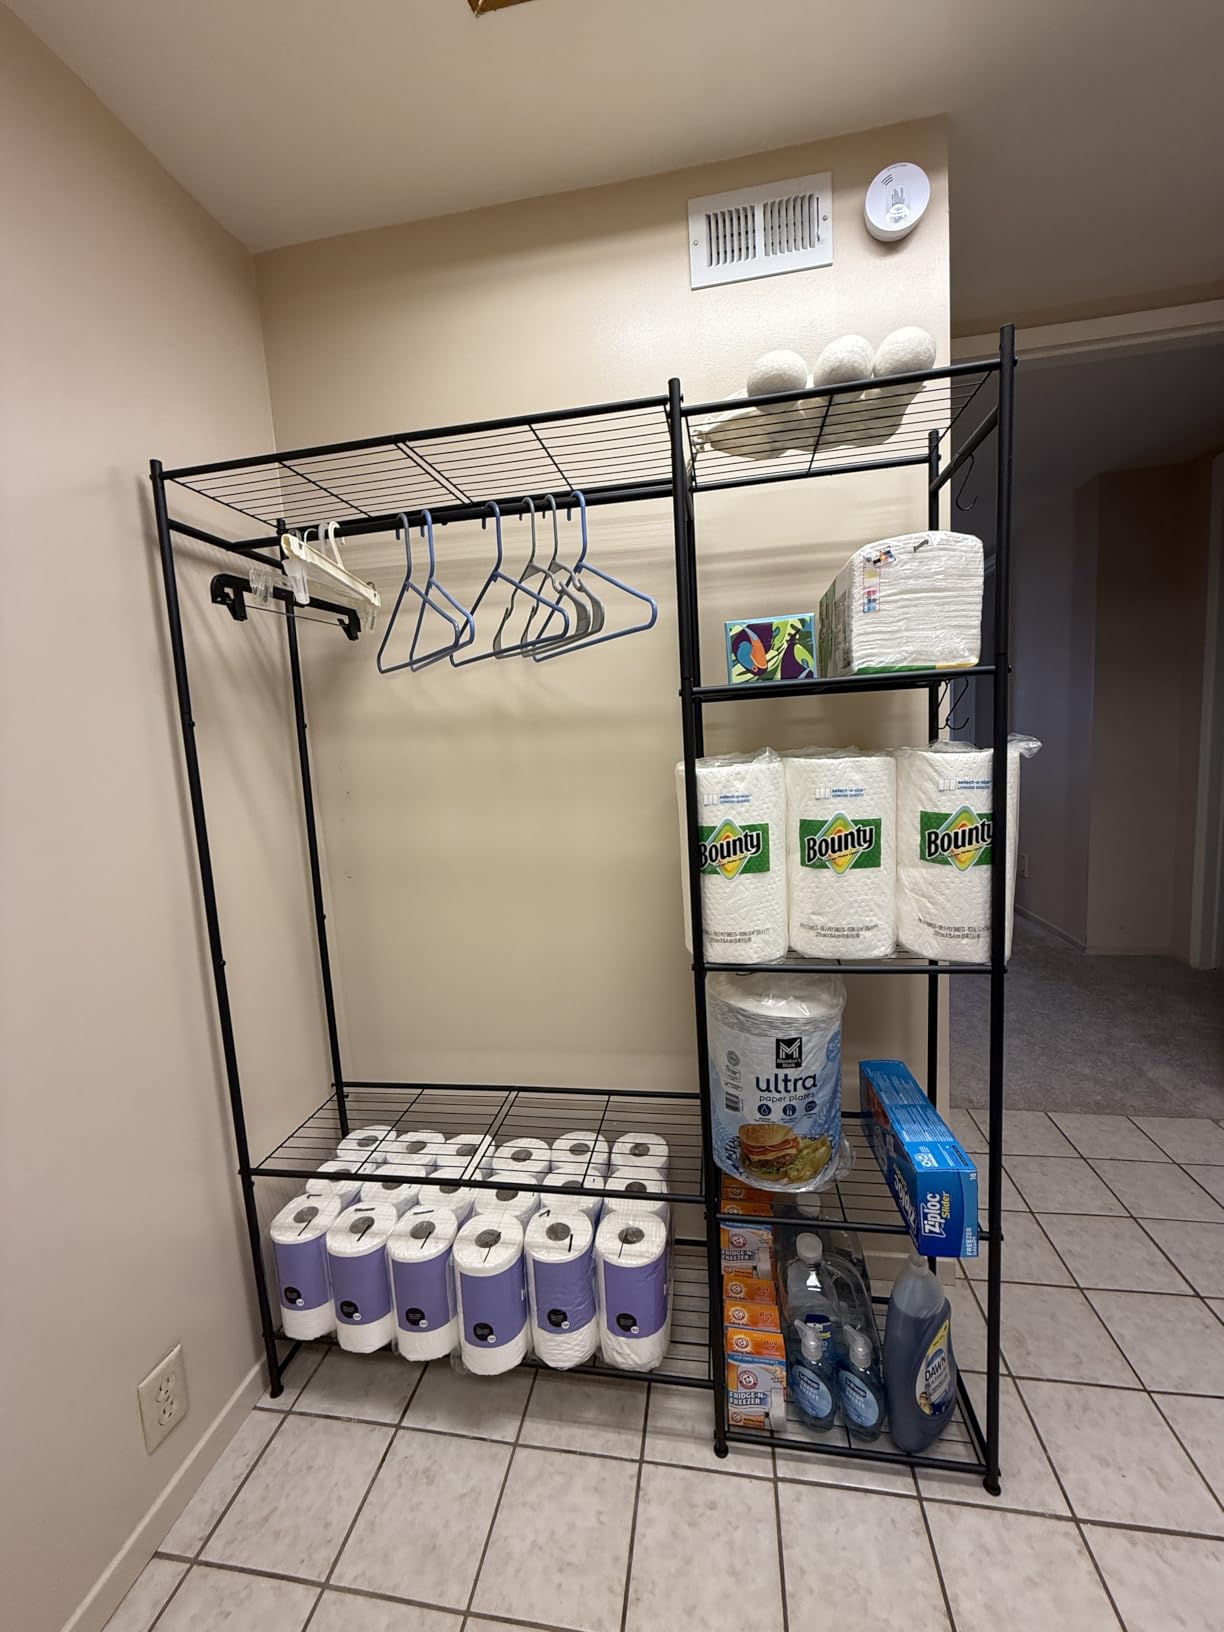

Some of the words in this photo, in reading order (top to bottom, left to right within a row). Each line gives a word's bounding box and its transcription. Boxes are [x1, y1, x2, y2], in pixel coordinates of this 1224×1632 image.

[697, 831, 761, 869] Bounty
[806, 826, 874, 863] Bounty
[755, 1073, 818, 1094] ultra
[759, 1095, 786, 1104] paper
[788, 1092, 815, 1102] plates
[924, 1193, 946, 1234] Ziploc
[942, 1192, 951, 1220] Slider
[924, 1355, 946, 1382] DAWN
